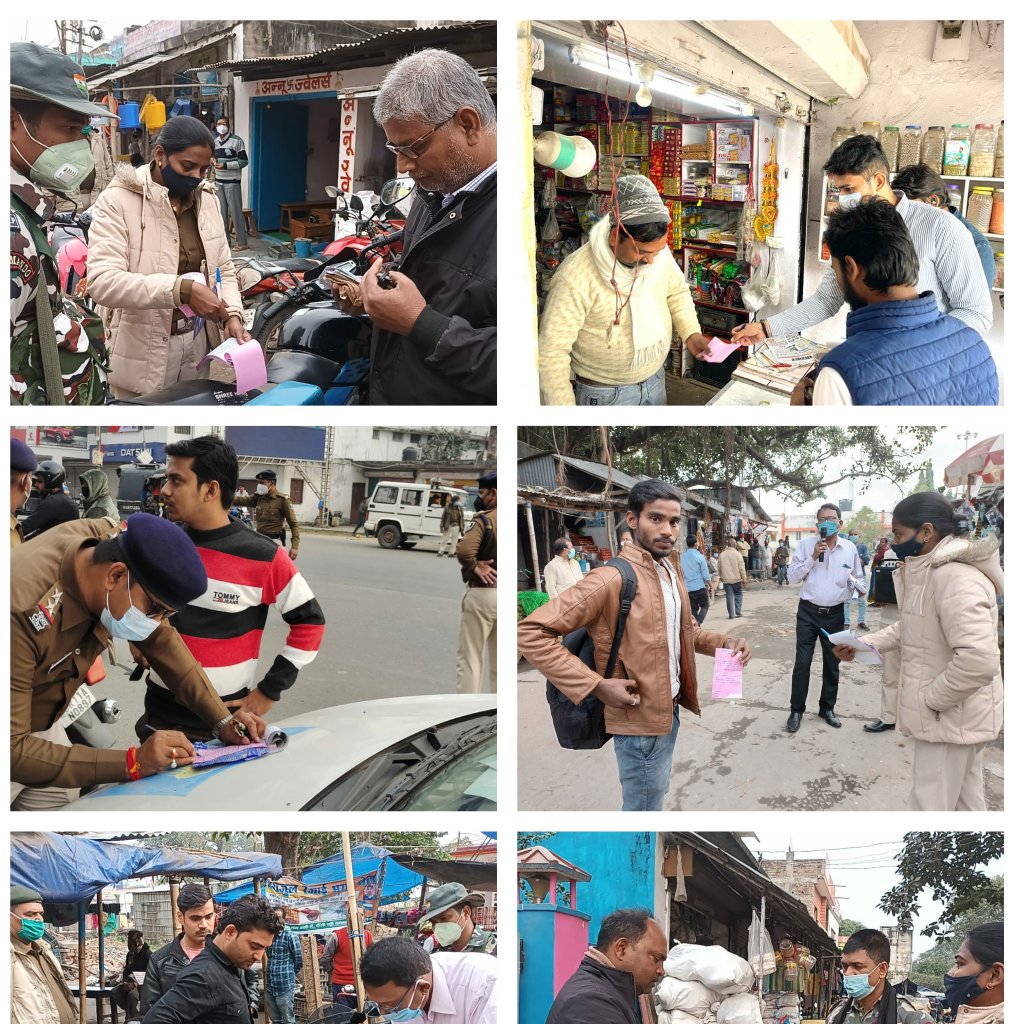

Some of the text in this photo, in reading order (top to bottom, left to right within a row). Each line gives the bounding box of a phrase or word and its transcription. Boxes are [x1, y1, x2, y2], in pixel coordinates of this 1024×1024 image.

[261, 72, 332, 95] अन्नू ज्वेलर्स
[213, 591, 240, 600] TOMMY
[68, 694, 92, 721] N0897
